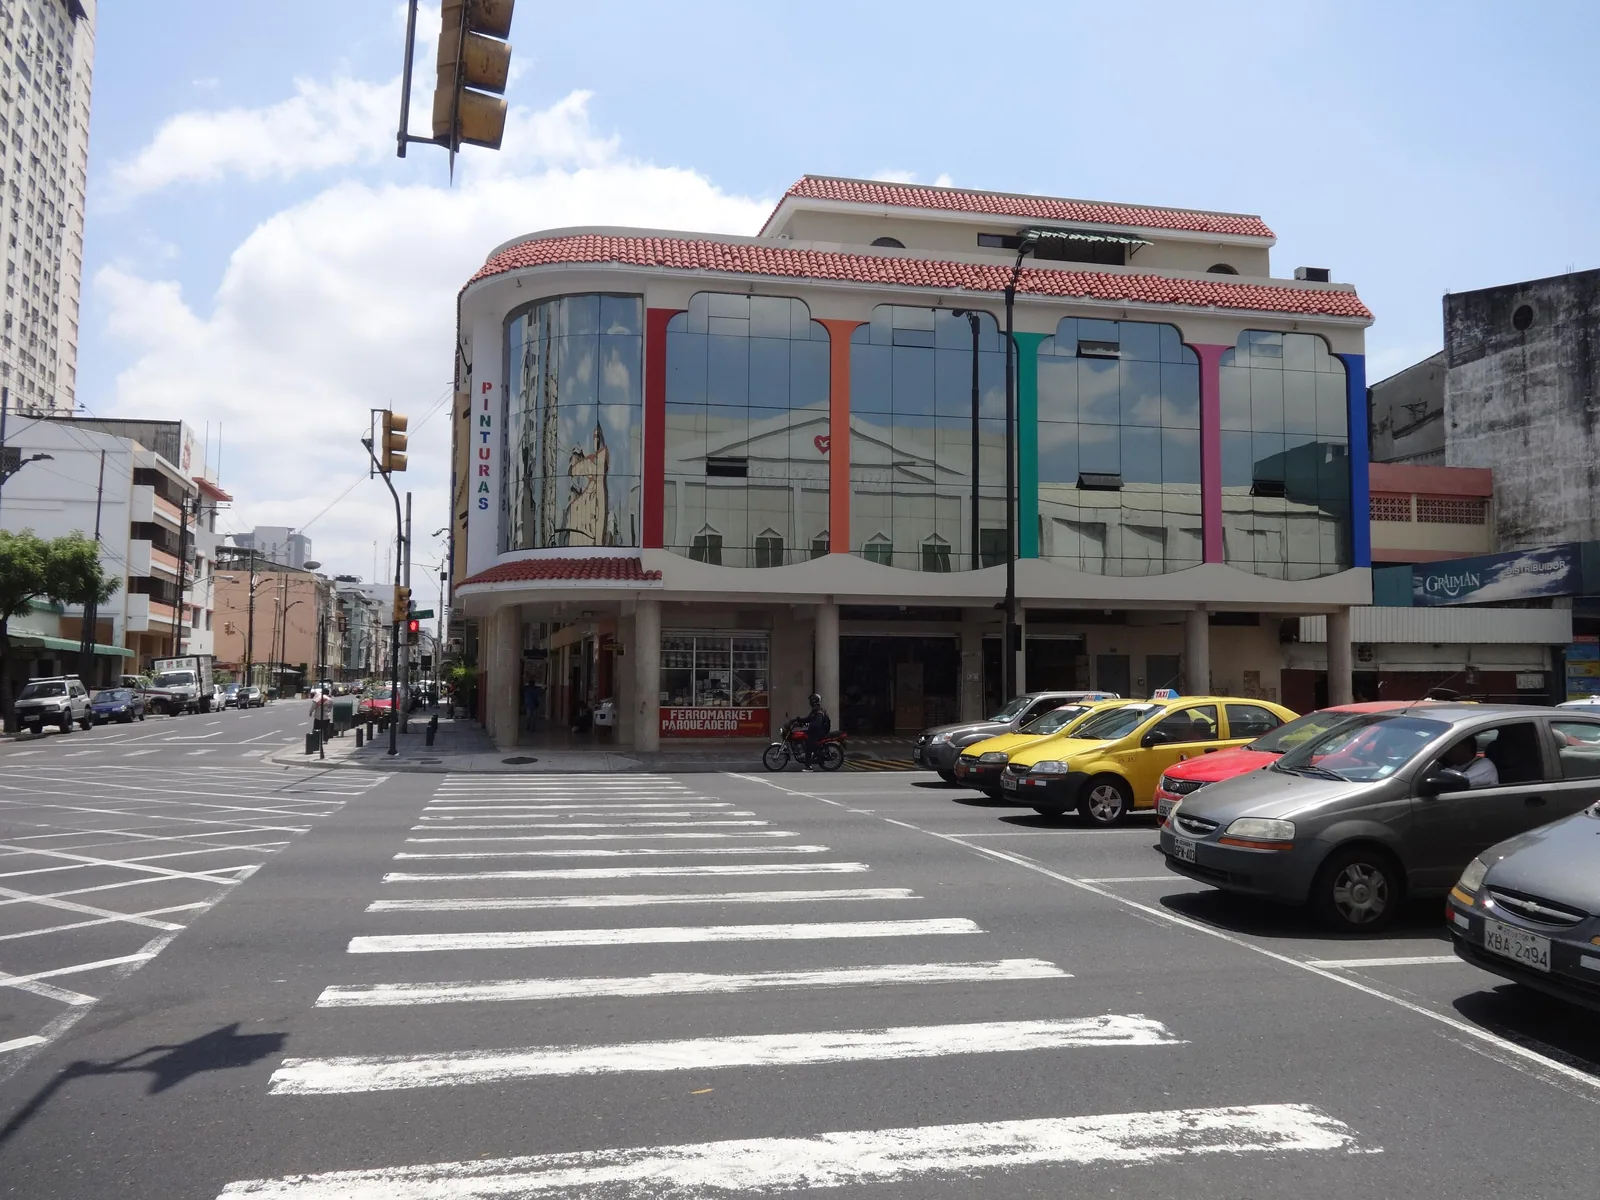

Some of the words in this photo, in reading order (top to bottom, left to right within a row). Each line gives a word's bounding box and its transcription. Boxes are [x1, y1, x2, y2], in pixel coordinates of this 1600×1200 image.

[478, 382, 492, 510] PINTURAS
[1506, 560, 1566, 575] DISTRIBUIDOR
[1426, 571, 1480, 596] GRAIMAN
[1155, 690, 1169, 699] TAXI
[670, 709, 753, 720] FERROMARKET
[662, 720, 738, 731] PARQUEADERO
[1486, 930, 1548, 967] XBA-2494
